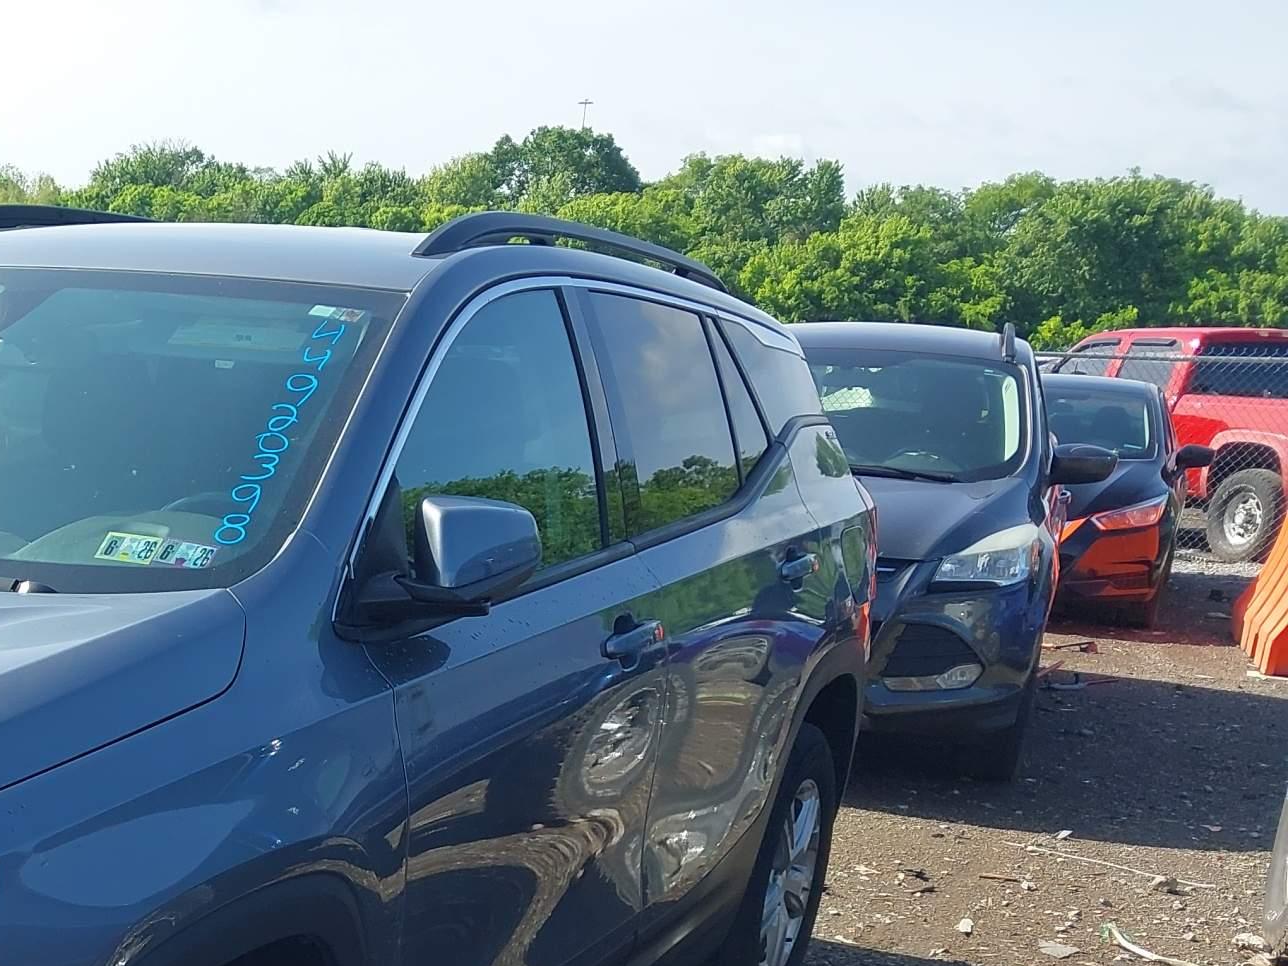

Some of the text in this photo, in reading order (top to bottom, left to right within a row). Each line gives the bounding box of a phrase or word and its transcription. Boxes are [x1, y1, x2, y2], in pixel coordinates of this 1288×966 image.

[213, 320, 346, 545] 44920398
[137, 540, 158, 561] 26
[193, 547, 214, 567] 26
